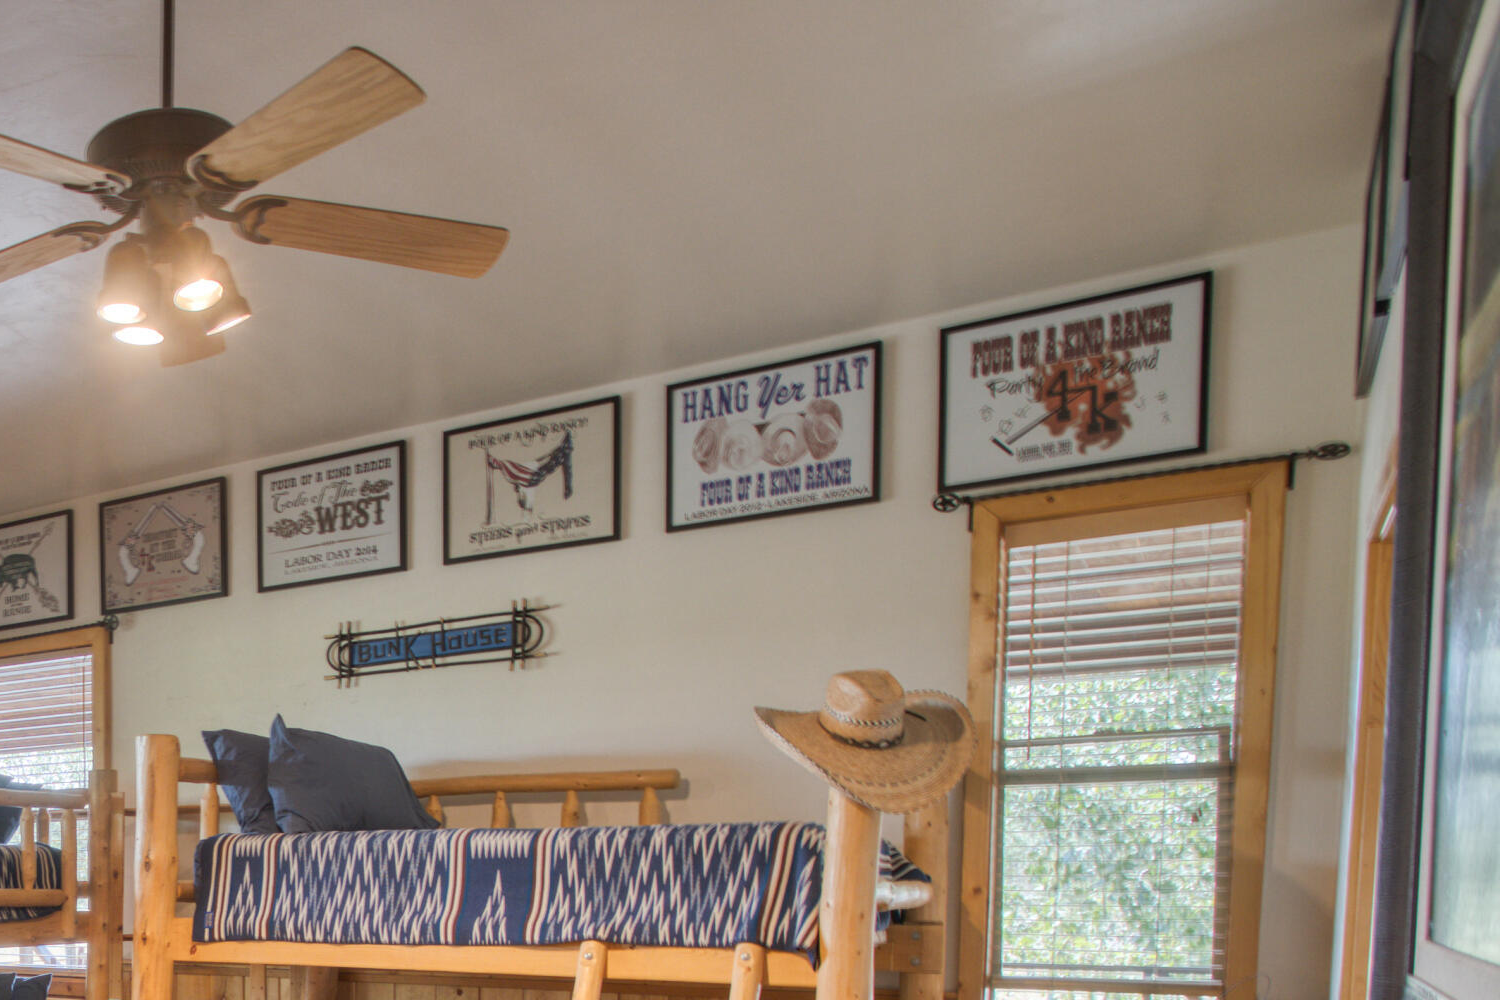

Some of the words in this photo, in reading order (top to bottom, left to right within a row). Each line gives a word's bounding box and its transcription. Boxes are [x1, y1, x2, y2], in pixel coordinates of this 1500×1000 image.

[971, 335, 1014, 378] FOUR
[1019, 330, 1040, 369] OF
[1044, 325, 1057, 366] A
[1062, 316, 1104, 361] KIND
[1109, 303, 1173, 352] RANCH
[681, 380, 749, 423] HANG
[756, 371, 806, 419] Yer
[813, 356, 869, 398] HAT
[270, 477, 297, 491] FOUR
[300, 471, 313, 485] OF
[315, 471, 323, 482] A
[325, 465, 352, 480] KIND
[354, 457, 392, 474] RANCH
[700, 478, 732, 507] FOUR
[736, 474, 752, 501] OF
[756, 471, 766, 498] A
[769, 466, 801, 496] KIND
[805, 457, 852, 491] RANCH
[314, 492, 390, 535] WEST
[284, 553, 323, 568] LABOR
[325, 547, 352, 562] DAY
[357, 628, 421, 670] BUNK
[431, 622, 508, 667] HOUSE
